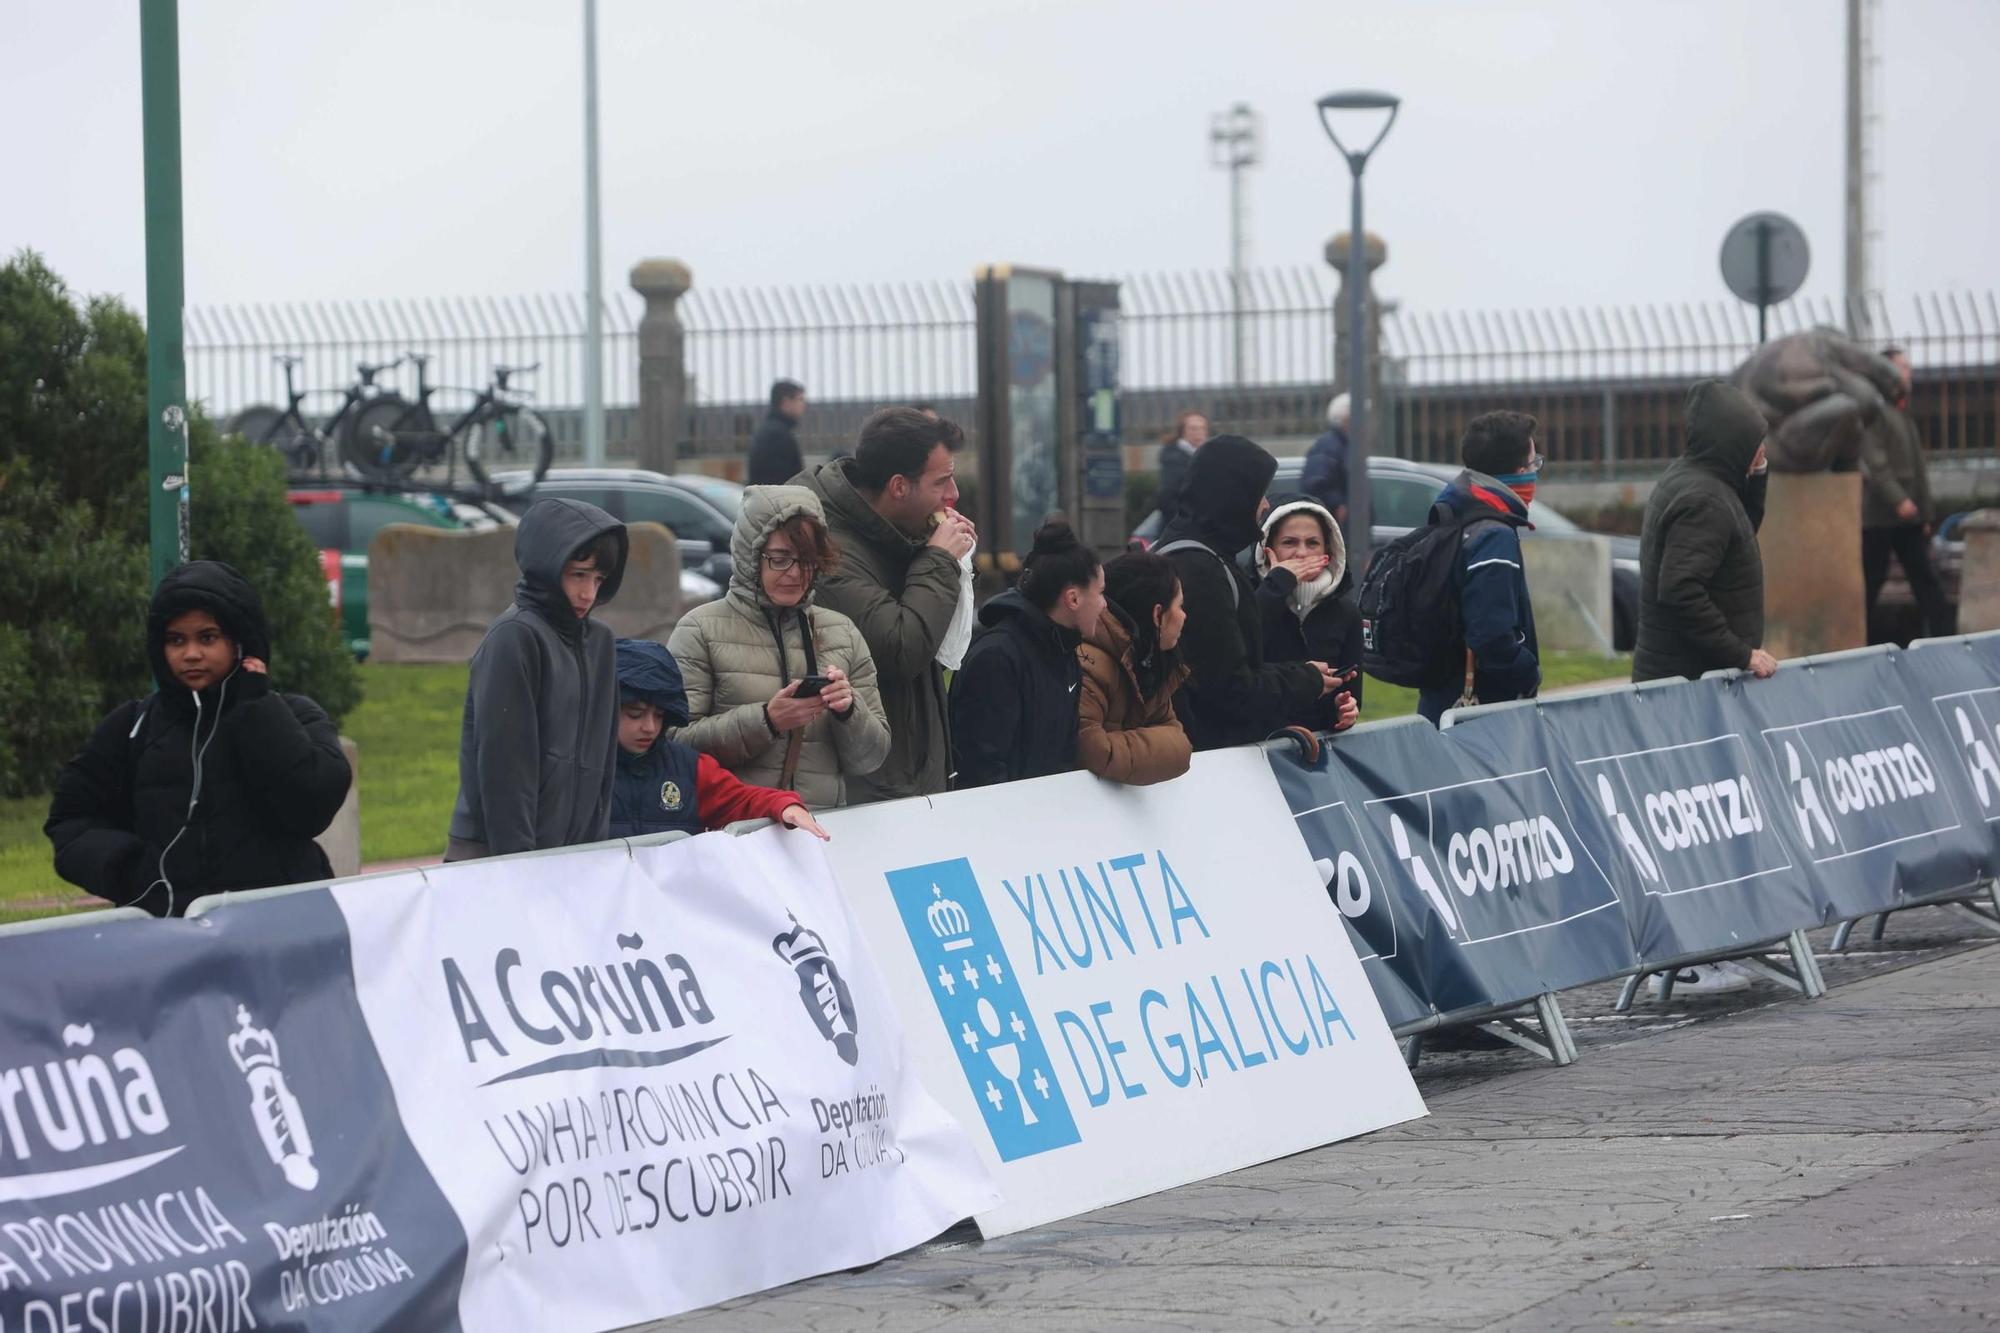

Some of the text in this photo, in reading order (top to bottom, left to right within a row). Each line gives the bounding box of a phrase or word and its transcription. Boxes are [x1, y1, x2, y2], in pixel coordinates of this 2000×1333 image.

[1645, 774, 1763, 852] CORTIZO
[1825, 742, 1935, 816] CORTIZO
[1448, 815, 1574, 896] CORTIZO
[1002, 850, 1210, 975] XUNTA
[442, 933, 715, 1062] A Coruña
[1055, 955, 1356, 1107] DE GALICIA
[0, 1022, 170, 1160] ruña
[484, 1068, 790, 1175] UNHA PROVINCIA
[519, 1137, 791, 1254] POR DESCUBRIR
[821, 1140, 849, 1178] DA
[2, 1186, 247, 1282] PROVINCIA
[263, 1203, 388, 1268] Deputación
[308, 1247, 415, 1305] CORUÑA
